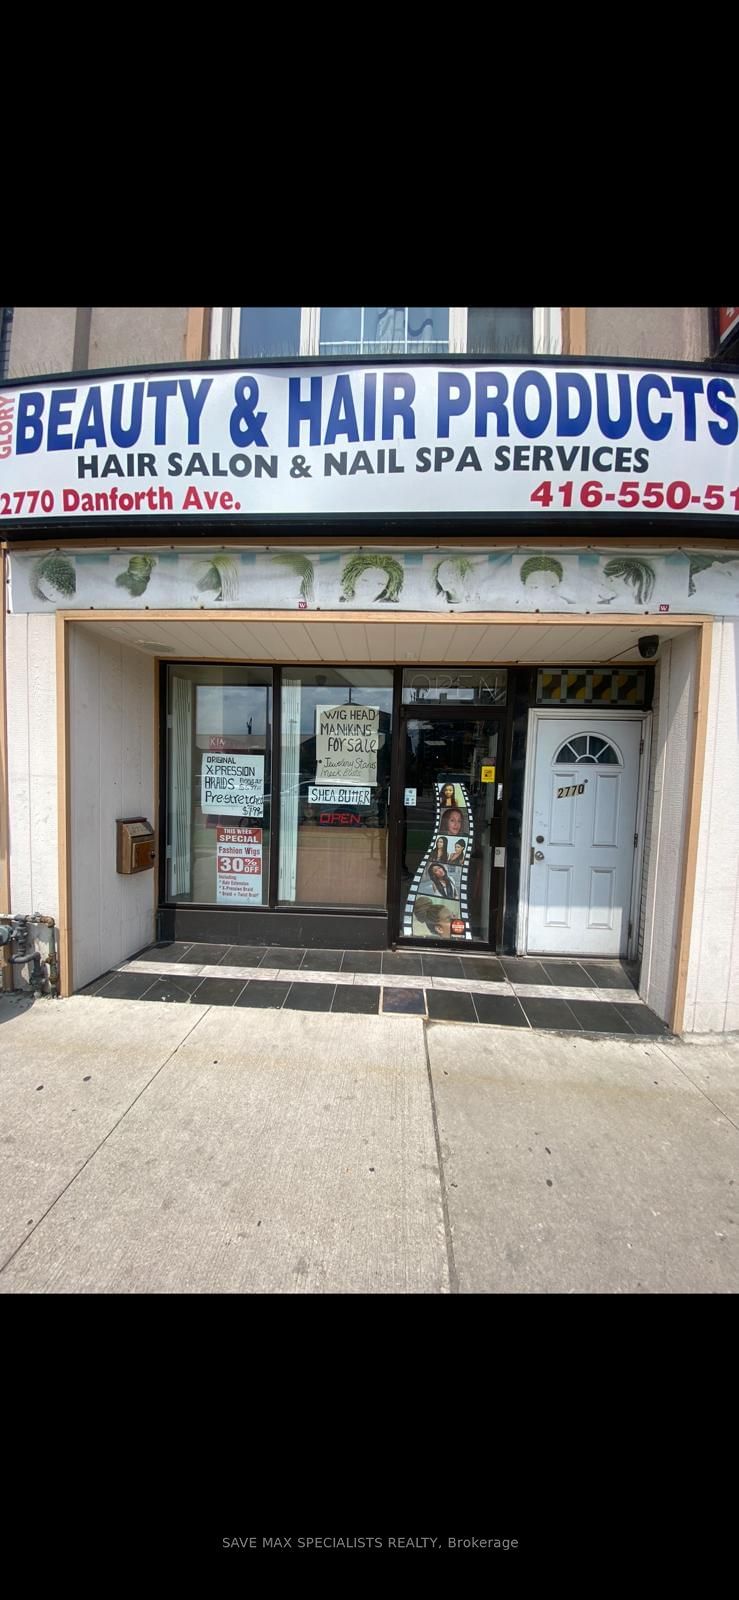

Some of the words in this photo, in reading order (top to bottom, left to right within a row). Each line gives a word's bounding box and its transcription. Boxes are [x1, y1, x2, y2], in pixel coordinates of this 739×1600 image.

[16, 379, 213, 455] BEAUTY
[230, 376, 269, 448] &
[288, 372, 416, 447] HAIR
[437, 370, 738, 445] PRODUCTS
[0, 396, 15, 459] GLORY
[78, 453, 158, 479] HAIR
[168, 452, 278, 478] SALON
[289, 455, 312, 478] &
[324, 449, 405, 476] NAIL
[415, 446, 482, 473] SPA
[494, 445, 649, 473] SERVICES
[0, 490, 54, 515] 2770
[62, 486, 173, 512] Danforth
[182, 486, 241, 510] Ave.
[324, 710, 347, 720] WIG
[350, 709, 376, 720] HEAD
[311, 788, 336, 802] SHEA
[557, 784, 585, 798] 2770
[320, 812, 361, 824] OPEN
[219, 834, 259, 843] SPECIAL
[219, 846, 243, 854] Fashion
[244, 847, 260, 856] Wigs
[220, 857, 244, 872] 30
